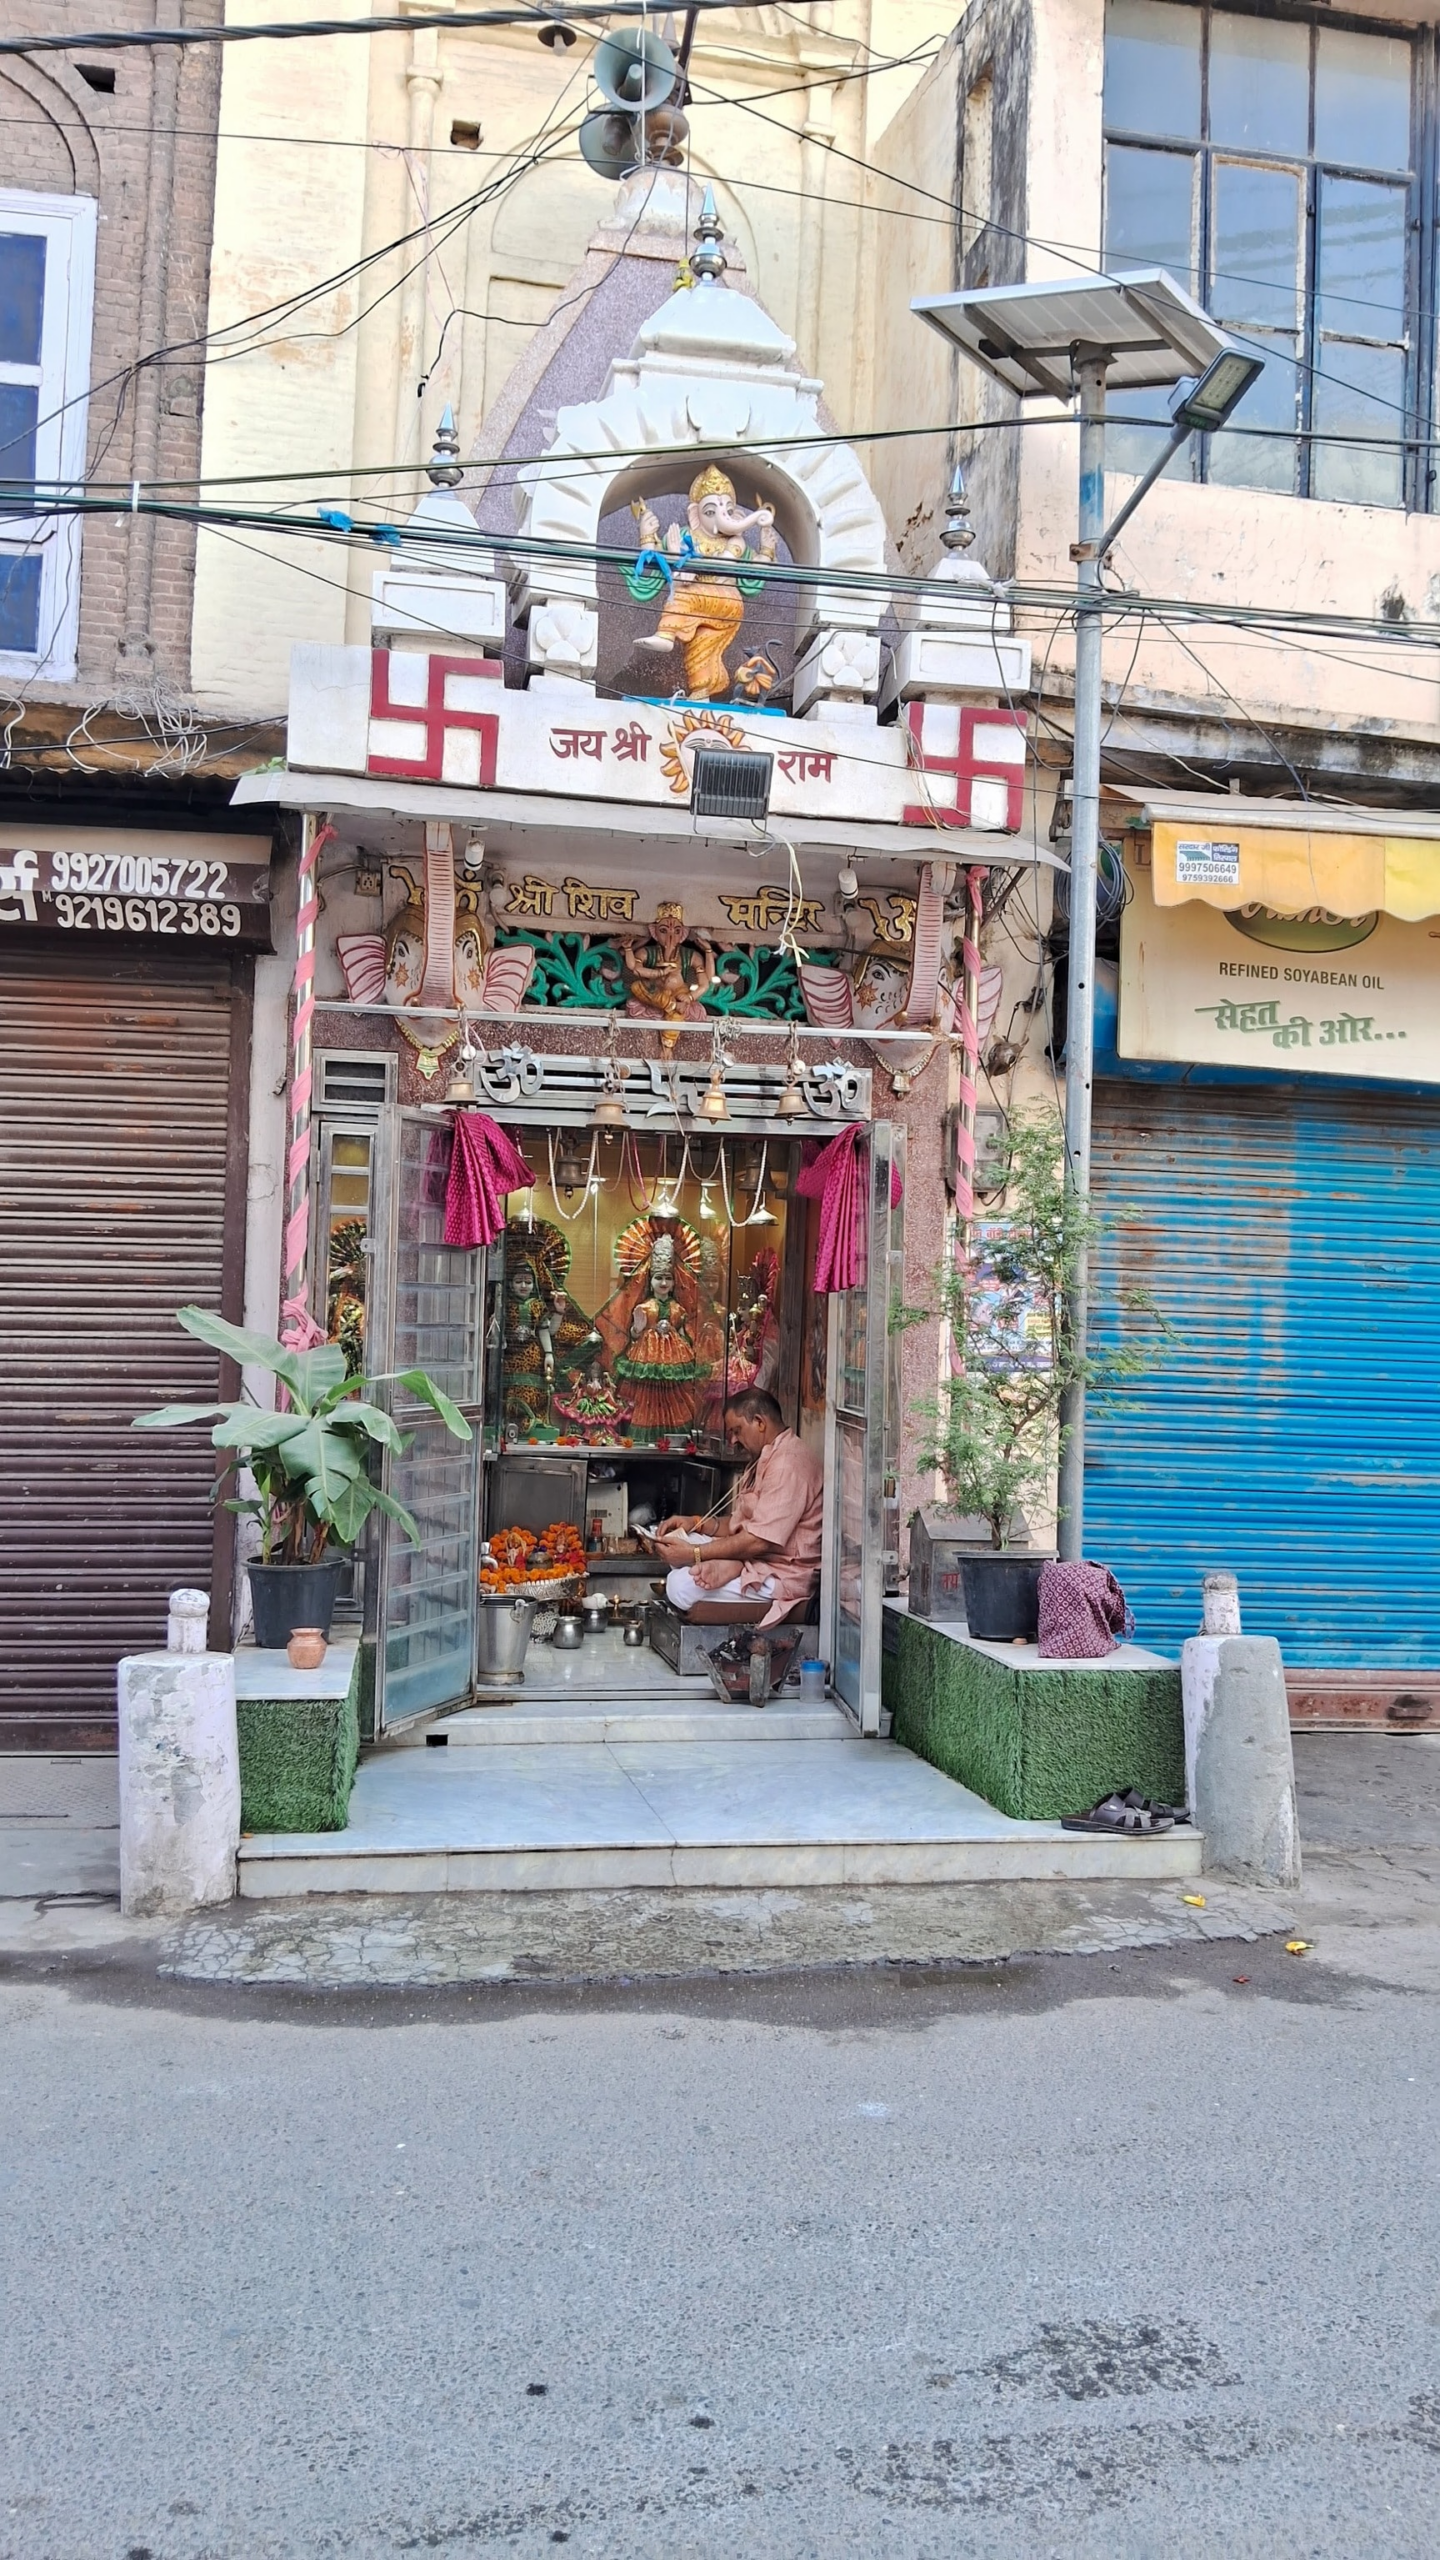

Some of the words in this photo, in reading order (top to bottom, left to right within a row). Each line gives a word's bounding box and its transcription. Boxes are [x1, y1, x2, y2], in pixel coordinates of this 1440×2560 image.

[549, 728, 607, 762] जय
[610, 721, 652, 762] श्री
[777, 750, 838, 784] राम
[51, 851, 228, 899] 9927005722
[1178, 862, 1237, 874] 9997506649
[1182, 873, 1233, 883] 9759392666
[54, 894, 241, 937] 9219612389
[503, 875, 560, 915] श्री
[562, 876, 640, 920] शिव
[1219, 962, 1279, 980] REFINED
[1284, 968, 1357, 987] SOYABEAN
[1362, 975, 1385, 990] OIL
[1195, 998, 1280, 1033] सेहत
[1255, 1016, 1313, 1048] की
